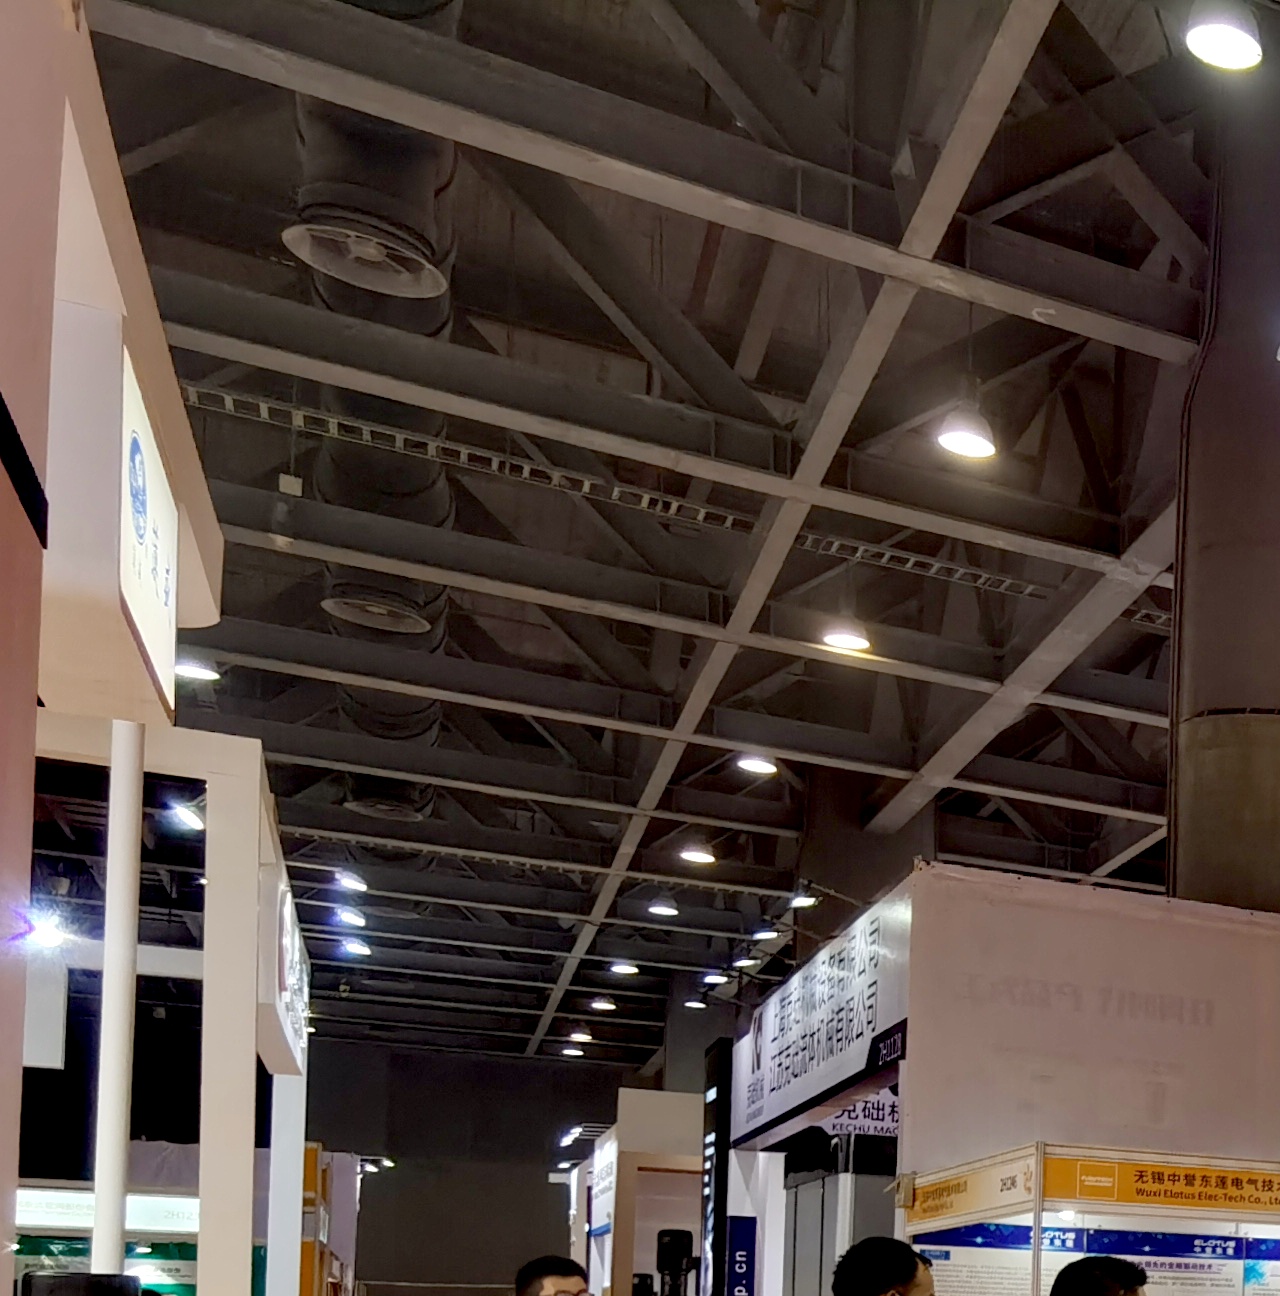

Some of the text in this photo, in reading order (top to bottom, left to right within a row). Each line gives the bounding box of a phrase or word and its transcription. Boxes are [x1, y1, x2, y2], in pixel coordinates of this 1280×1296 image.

[1135, 1186, 1162, 1198] Wuxi
[1163, 1188, 1196, 1201] Elotus
[1198, 1191, 1246, 1204] Elec-Tech
